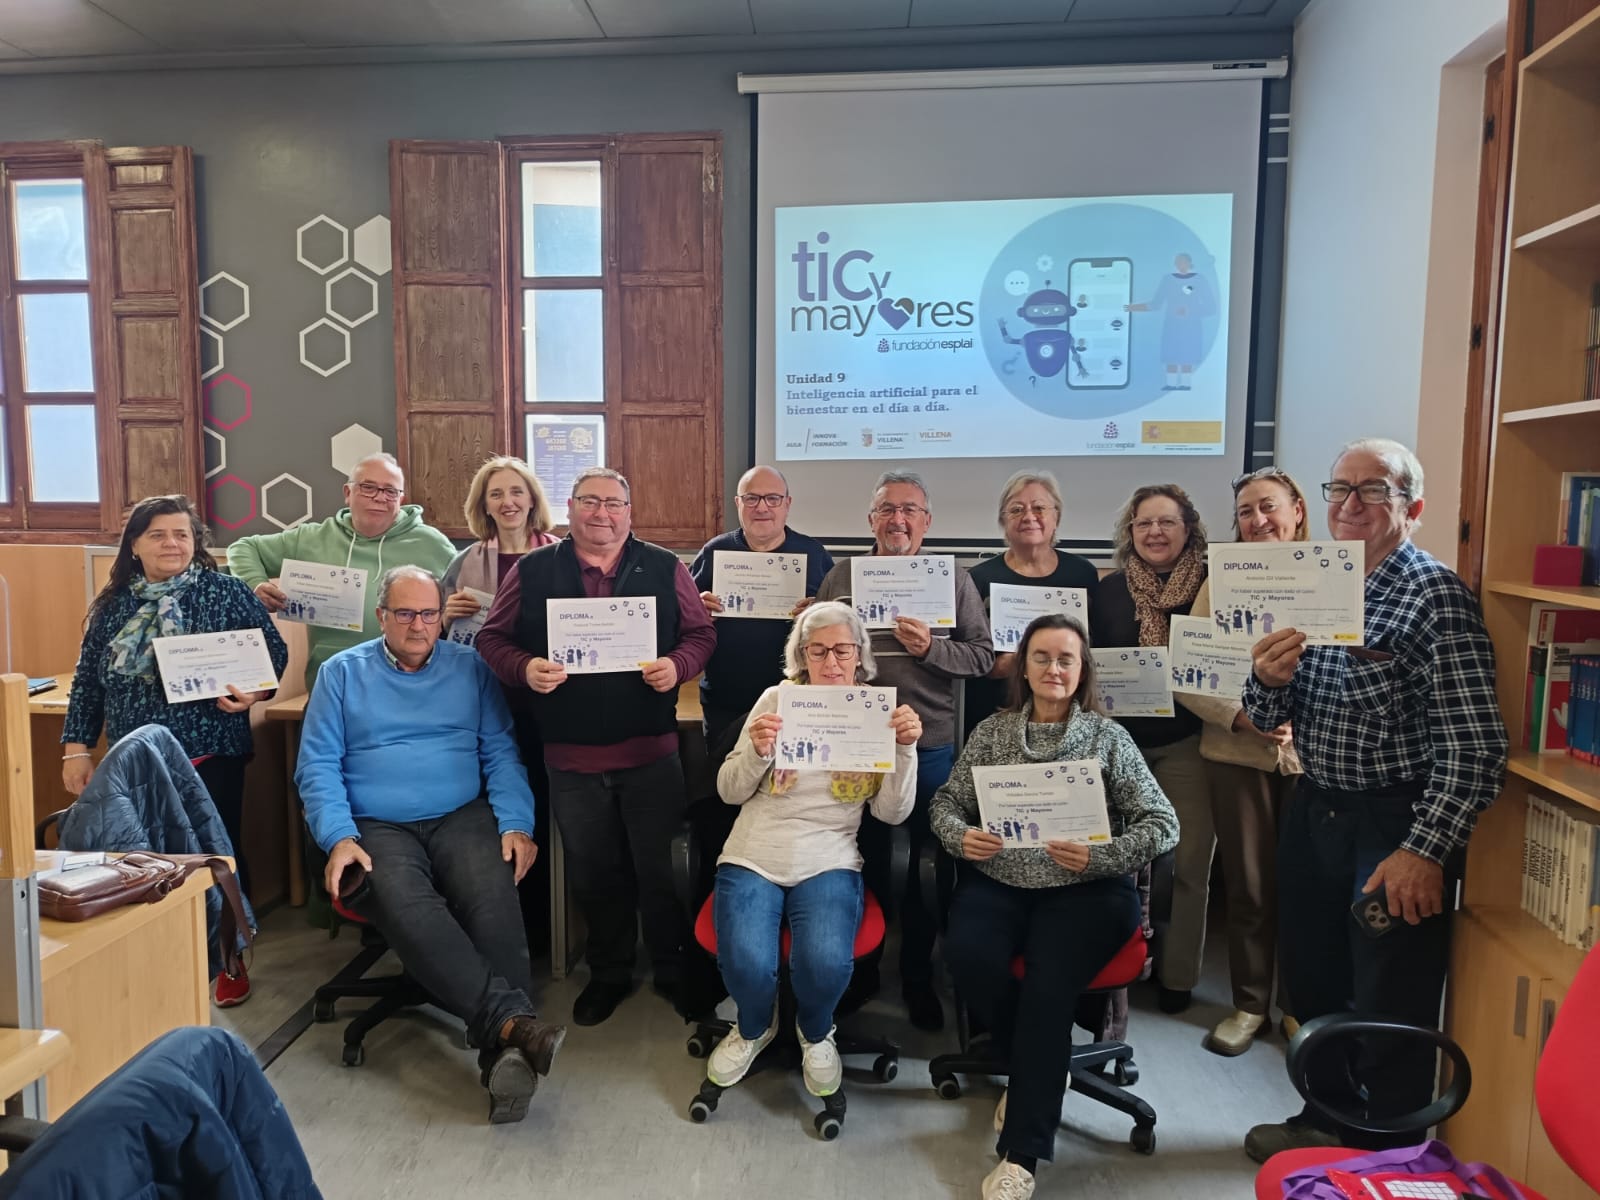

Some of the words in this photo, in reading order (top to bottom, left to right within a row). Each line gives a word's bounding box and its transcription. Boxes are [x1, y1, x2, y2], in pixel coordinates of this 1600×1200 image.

[786, 373, 833, 384] Unidad
[837, 373, 846, 383] 9
[786, 388, 865, 401] Inteligencia
[869, 386, 927, 399] artificial
[931, 387, 961, 399] para
[965, 385, 978, 396] el
[786, 405, 848, 415] bienestar
[852, 405, 868, 414] en
[872, 403, 885, 413] el
[889, 403, 909, 413] día
[913, 405, 921, 413] a
[925, 402, 950, 413] día.
[919, 431, 953, 439] VILLENA
[1224, 562, 1263, 570] DIPLOMA
[989, 781, 1022, 789] DIPLOMA
